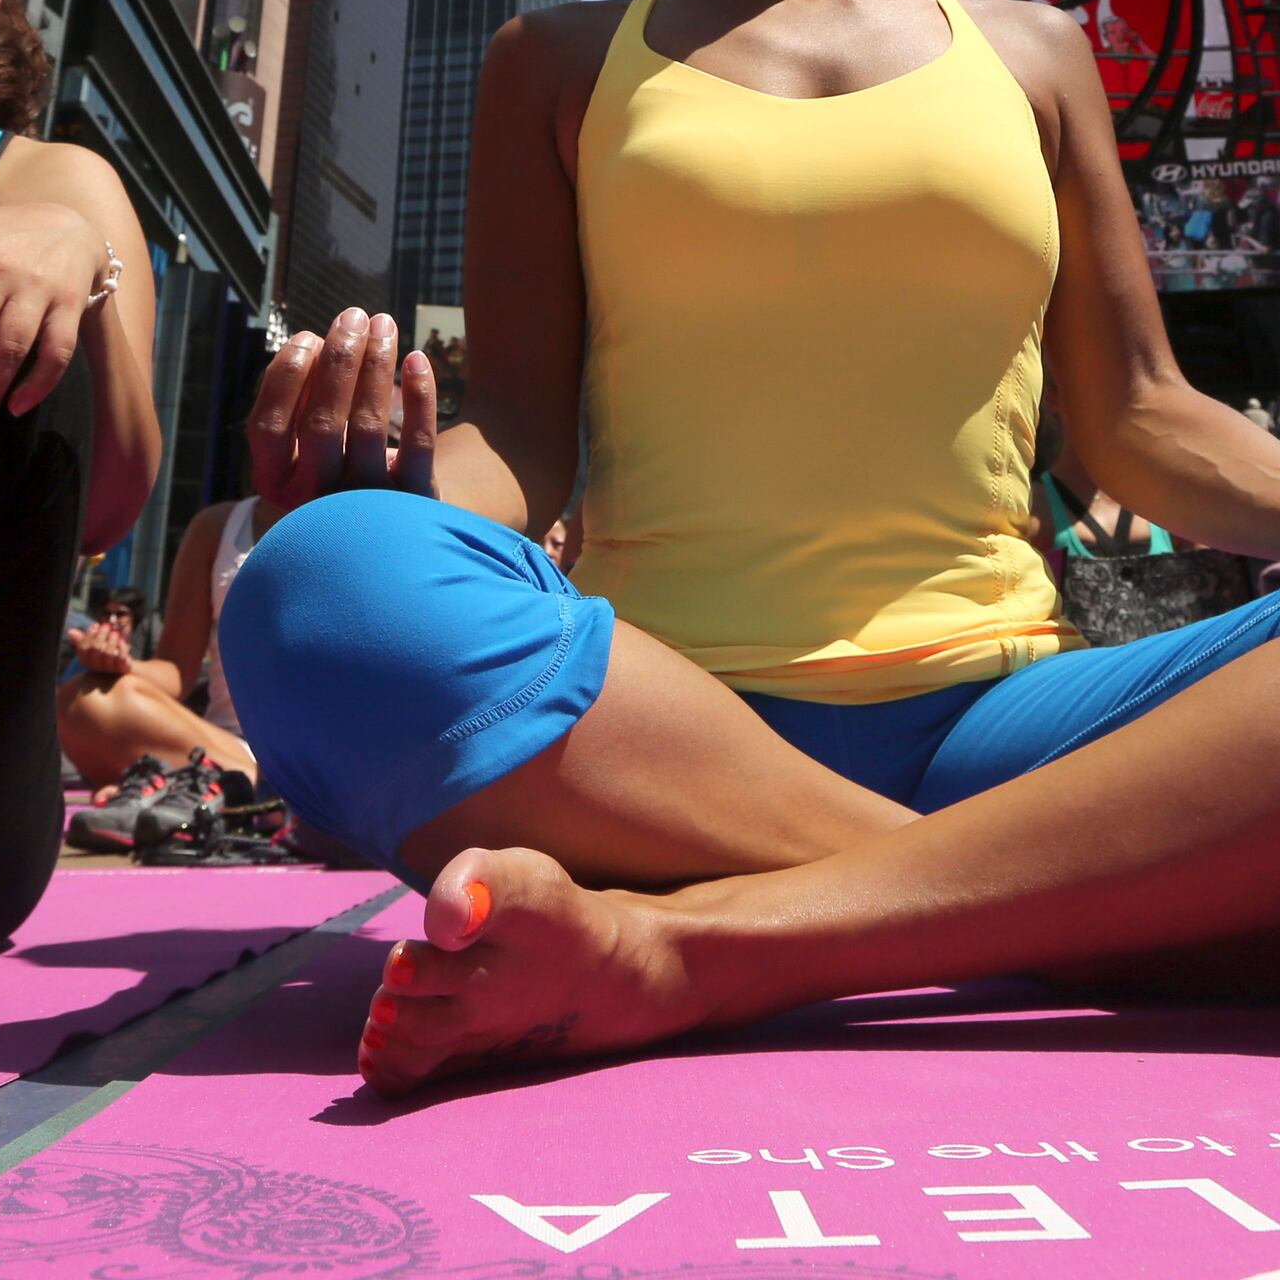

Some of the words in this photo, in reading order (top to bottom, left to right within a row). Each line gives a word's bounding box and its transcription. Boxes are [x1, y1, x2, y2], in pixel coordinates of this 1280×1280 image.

[687, 1145, 896, 1170] She
[927, 1140, 1100, 1165] the
[1127, 1135, 1236, 1157] to
